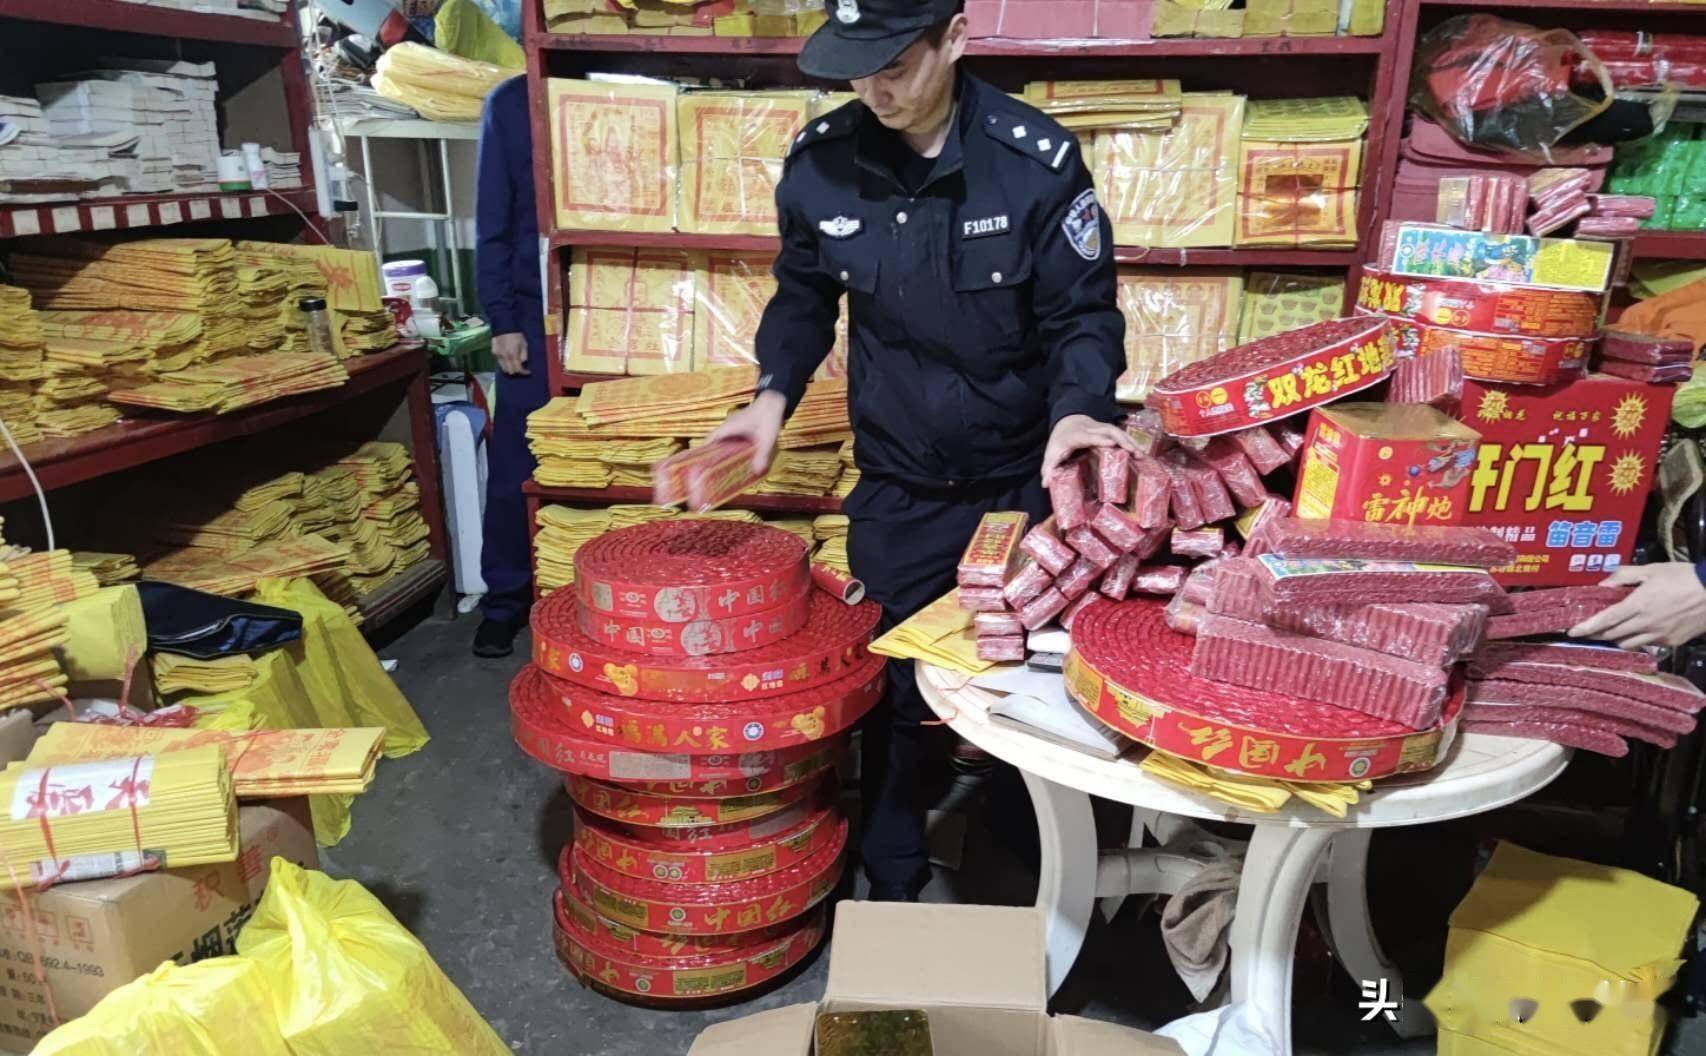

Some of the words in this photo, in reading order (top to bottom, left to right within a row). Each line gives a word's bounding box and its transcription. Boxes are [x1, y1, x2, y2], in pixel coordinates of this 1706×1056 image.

[964, 215, 1008, 235] F10178
[1469, 441, 1606, 511] 开门红
[1362, 485, 1453, 528] 雷神炮
[1546, 520, 1622, 547] 笛音雷
[1177, 721, 1327, 777] 中国红
[704, 895, 792, 929] 中国红
